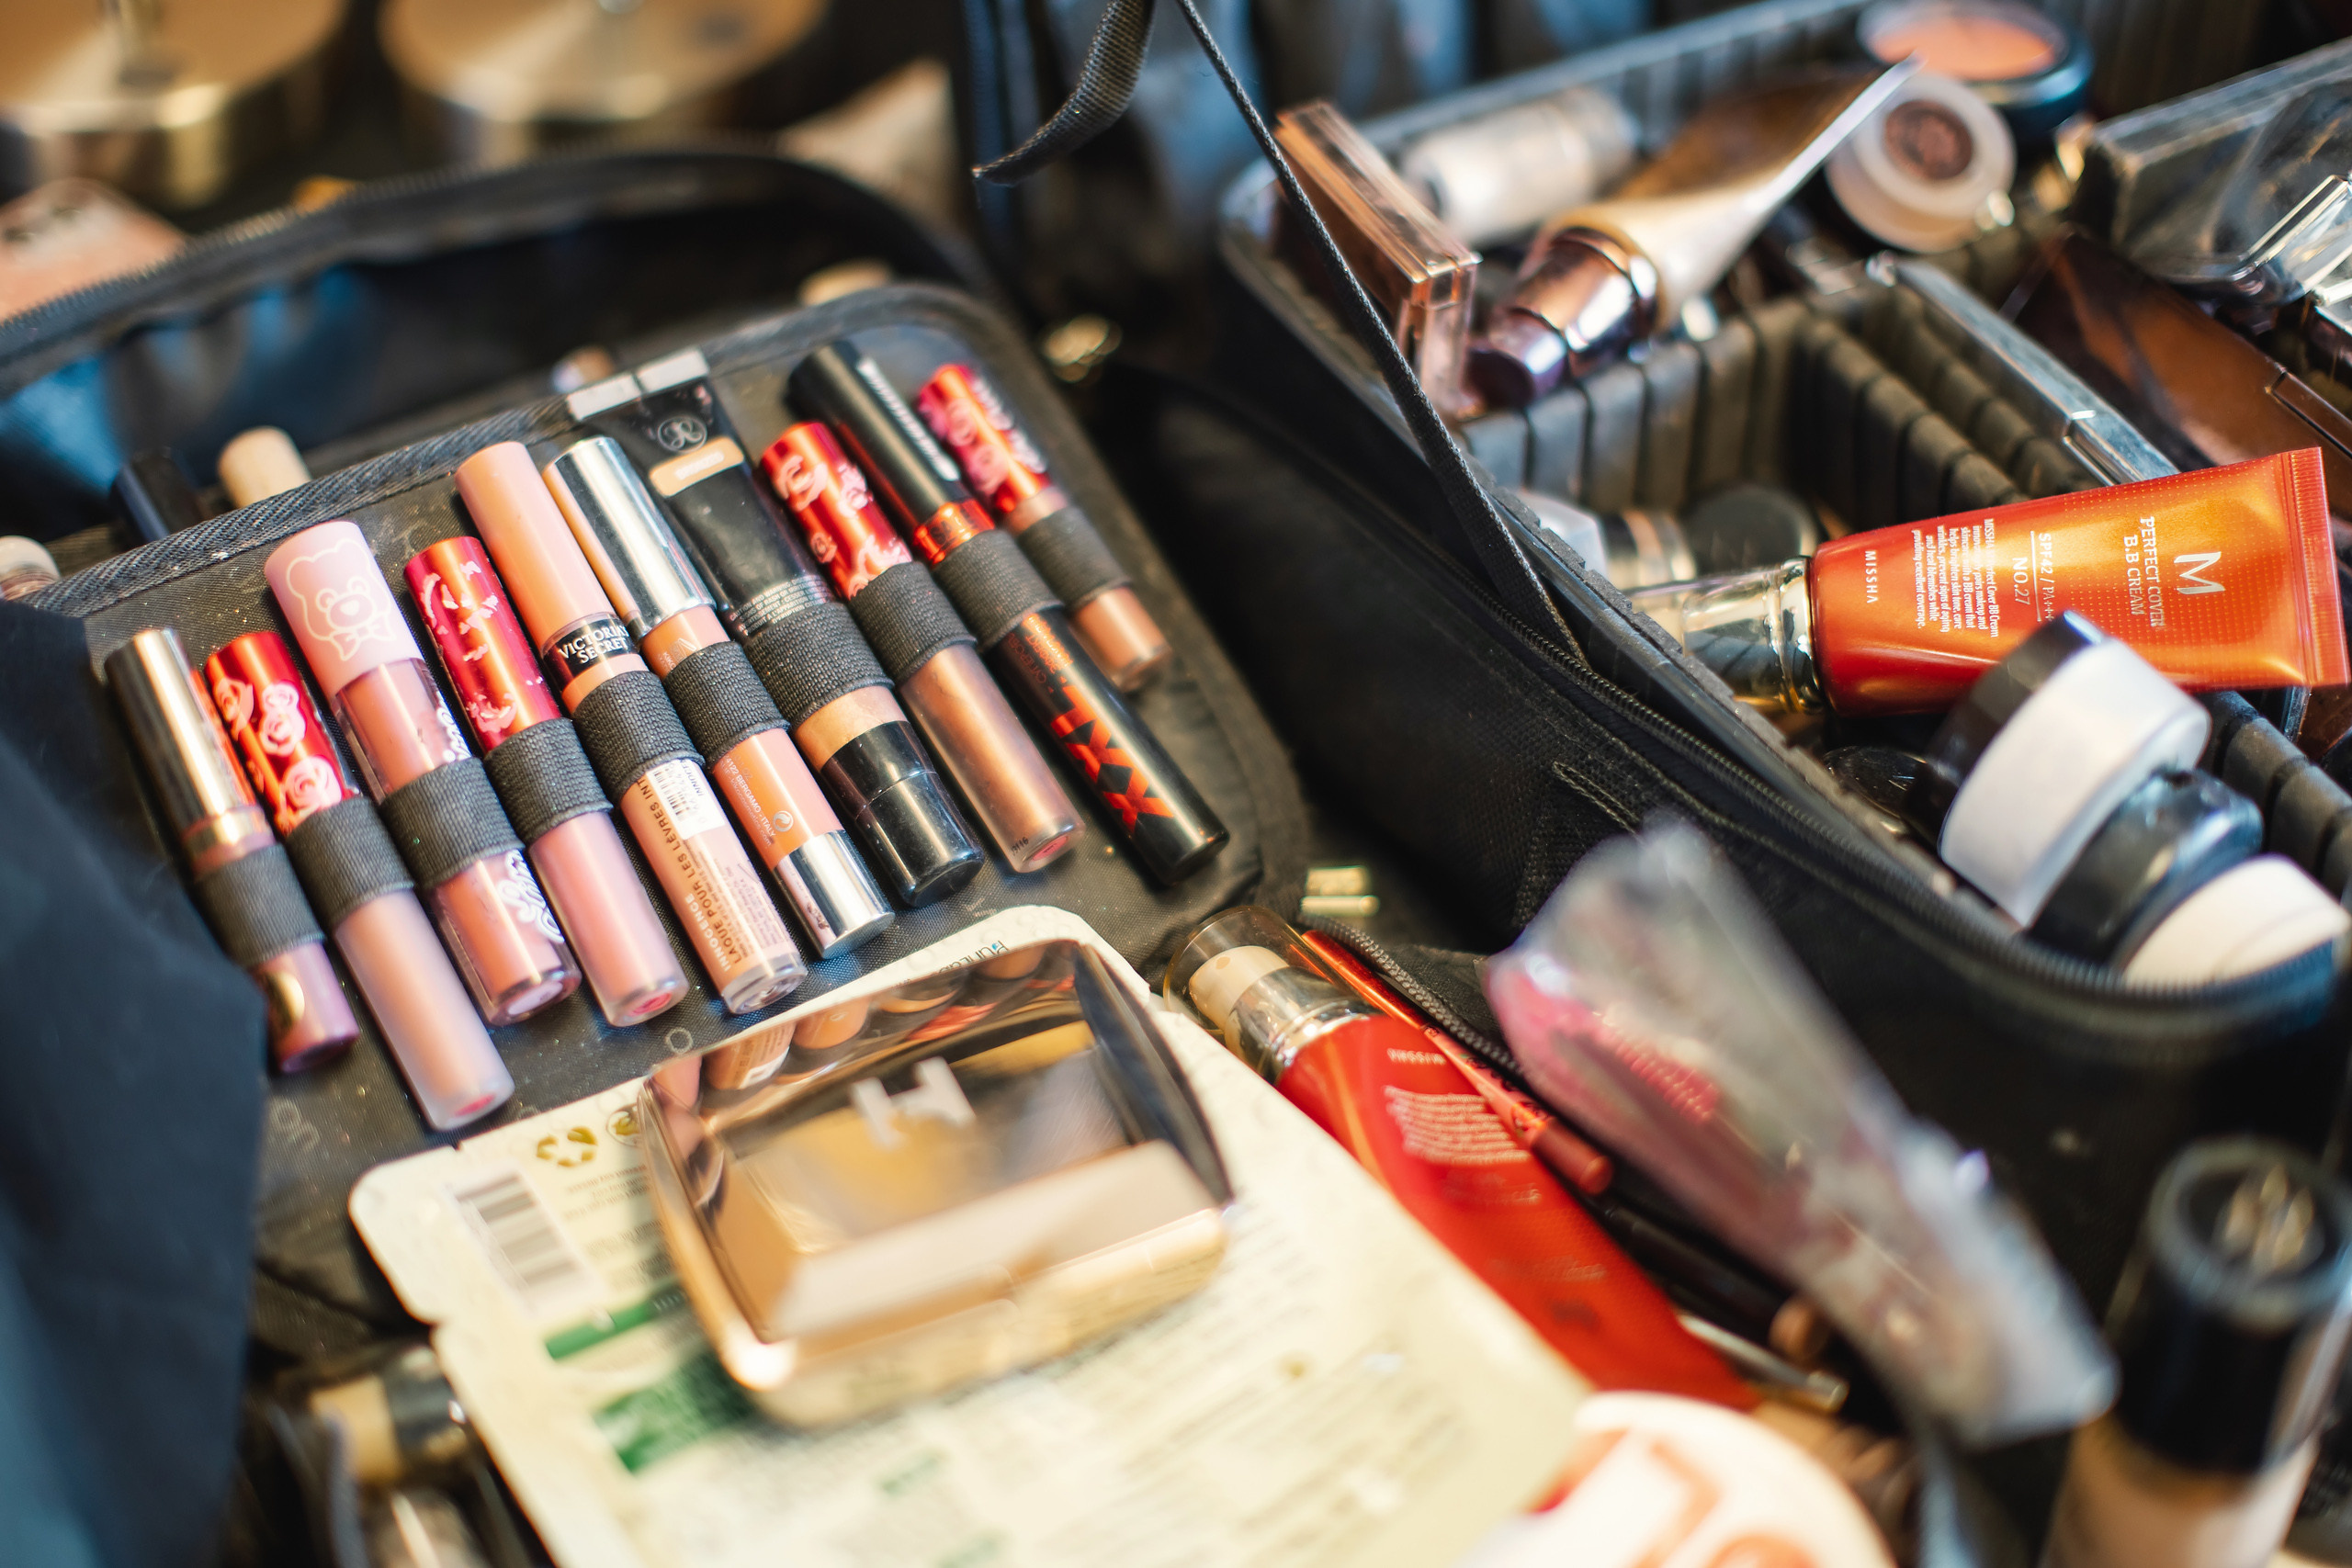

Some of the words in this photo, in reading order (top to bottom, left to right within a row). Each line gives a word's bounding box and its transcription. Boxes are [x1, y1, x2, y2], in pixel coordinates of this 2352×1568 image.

[1911, 529, 1923, 561] providing
[1925, 535, 1934, 549] and
[1949, 527, 1959, 547] helps
[1984, 518, 1995, 548] MISSHA
[1926, 549, 1934, 566] heal
[2038, 531, 2052, 574] SPF42
[2122, 534, 2139, 564] B.B
[2139, 515, 2159, 584] PERFECT
[1864, 550, 1880, 604] MISSHA
[1914, 561, 1927, 592] excellent
[1937, 556, 1946, 584] prevent
[1950, 547, 1961, 581] brighten
[2173, 547, 2228, 599] M
[1926, 566, 1937, 601] blemishes
[1938, 584, 1947, 602] signs
[1951, 581, 1960, 595] skin
[1962, 581, 1972, 592] BB
[1973, 571, 1983, 590] pairs
[1986, 585, 1996, 604] Cover
[2011, 555, 2031, 606] NO.27
[2126, 567, 2144, 615] CREAM
[729, 602, 752, 621] CAUTION
[751, 593, 764, 605] AND
[755, 602, 763, 610] OF
[763, 592, 781, 604] RASH
[779, 589, 789, 597] OR
[1916, 593, 1926, 628] coverage.
[1928, 601, 1939, 621] while
[1941, 603, 1950, 611] of
[1962, 592, 1972, 613] cream
[1975, 590, 1984, 615] makeup
[1988, 604, 1997, 615] BB
[2146, 585, 2165, 627] COVER
[1939, 610, 1950, 632] aging
[1965, 614, 1974, 628] that
[1977, 615, 1987, 630] and
[1989, 615, 1998, 637] Cream
[576, 636, 628, 664] SECRET
[1050, 685, 1173, 833] XXL
[735, 774, 762, 813] BERGAMO
[760, 816, 775, 837] ITALY
[648, 800, 682, 852] LÈVRES
[676, 852, 696, 878] LES
[691, 879, 718, 917] POUR
[683, 892, 733, 972] INNOCENCE
[713, 918, 744, 964] LAQUE
